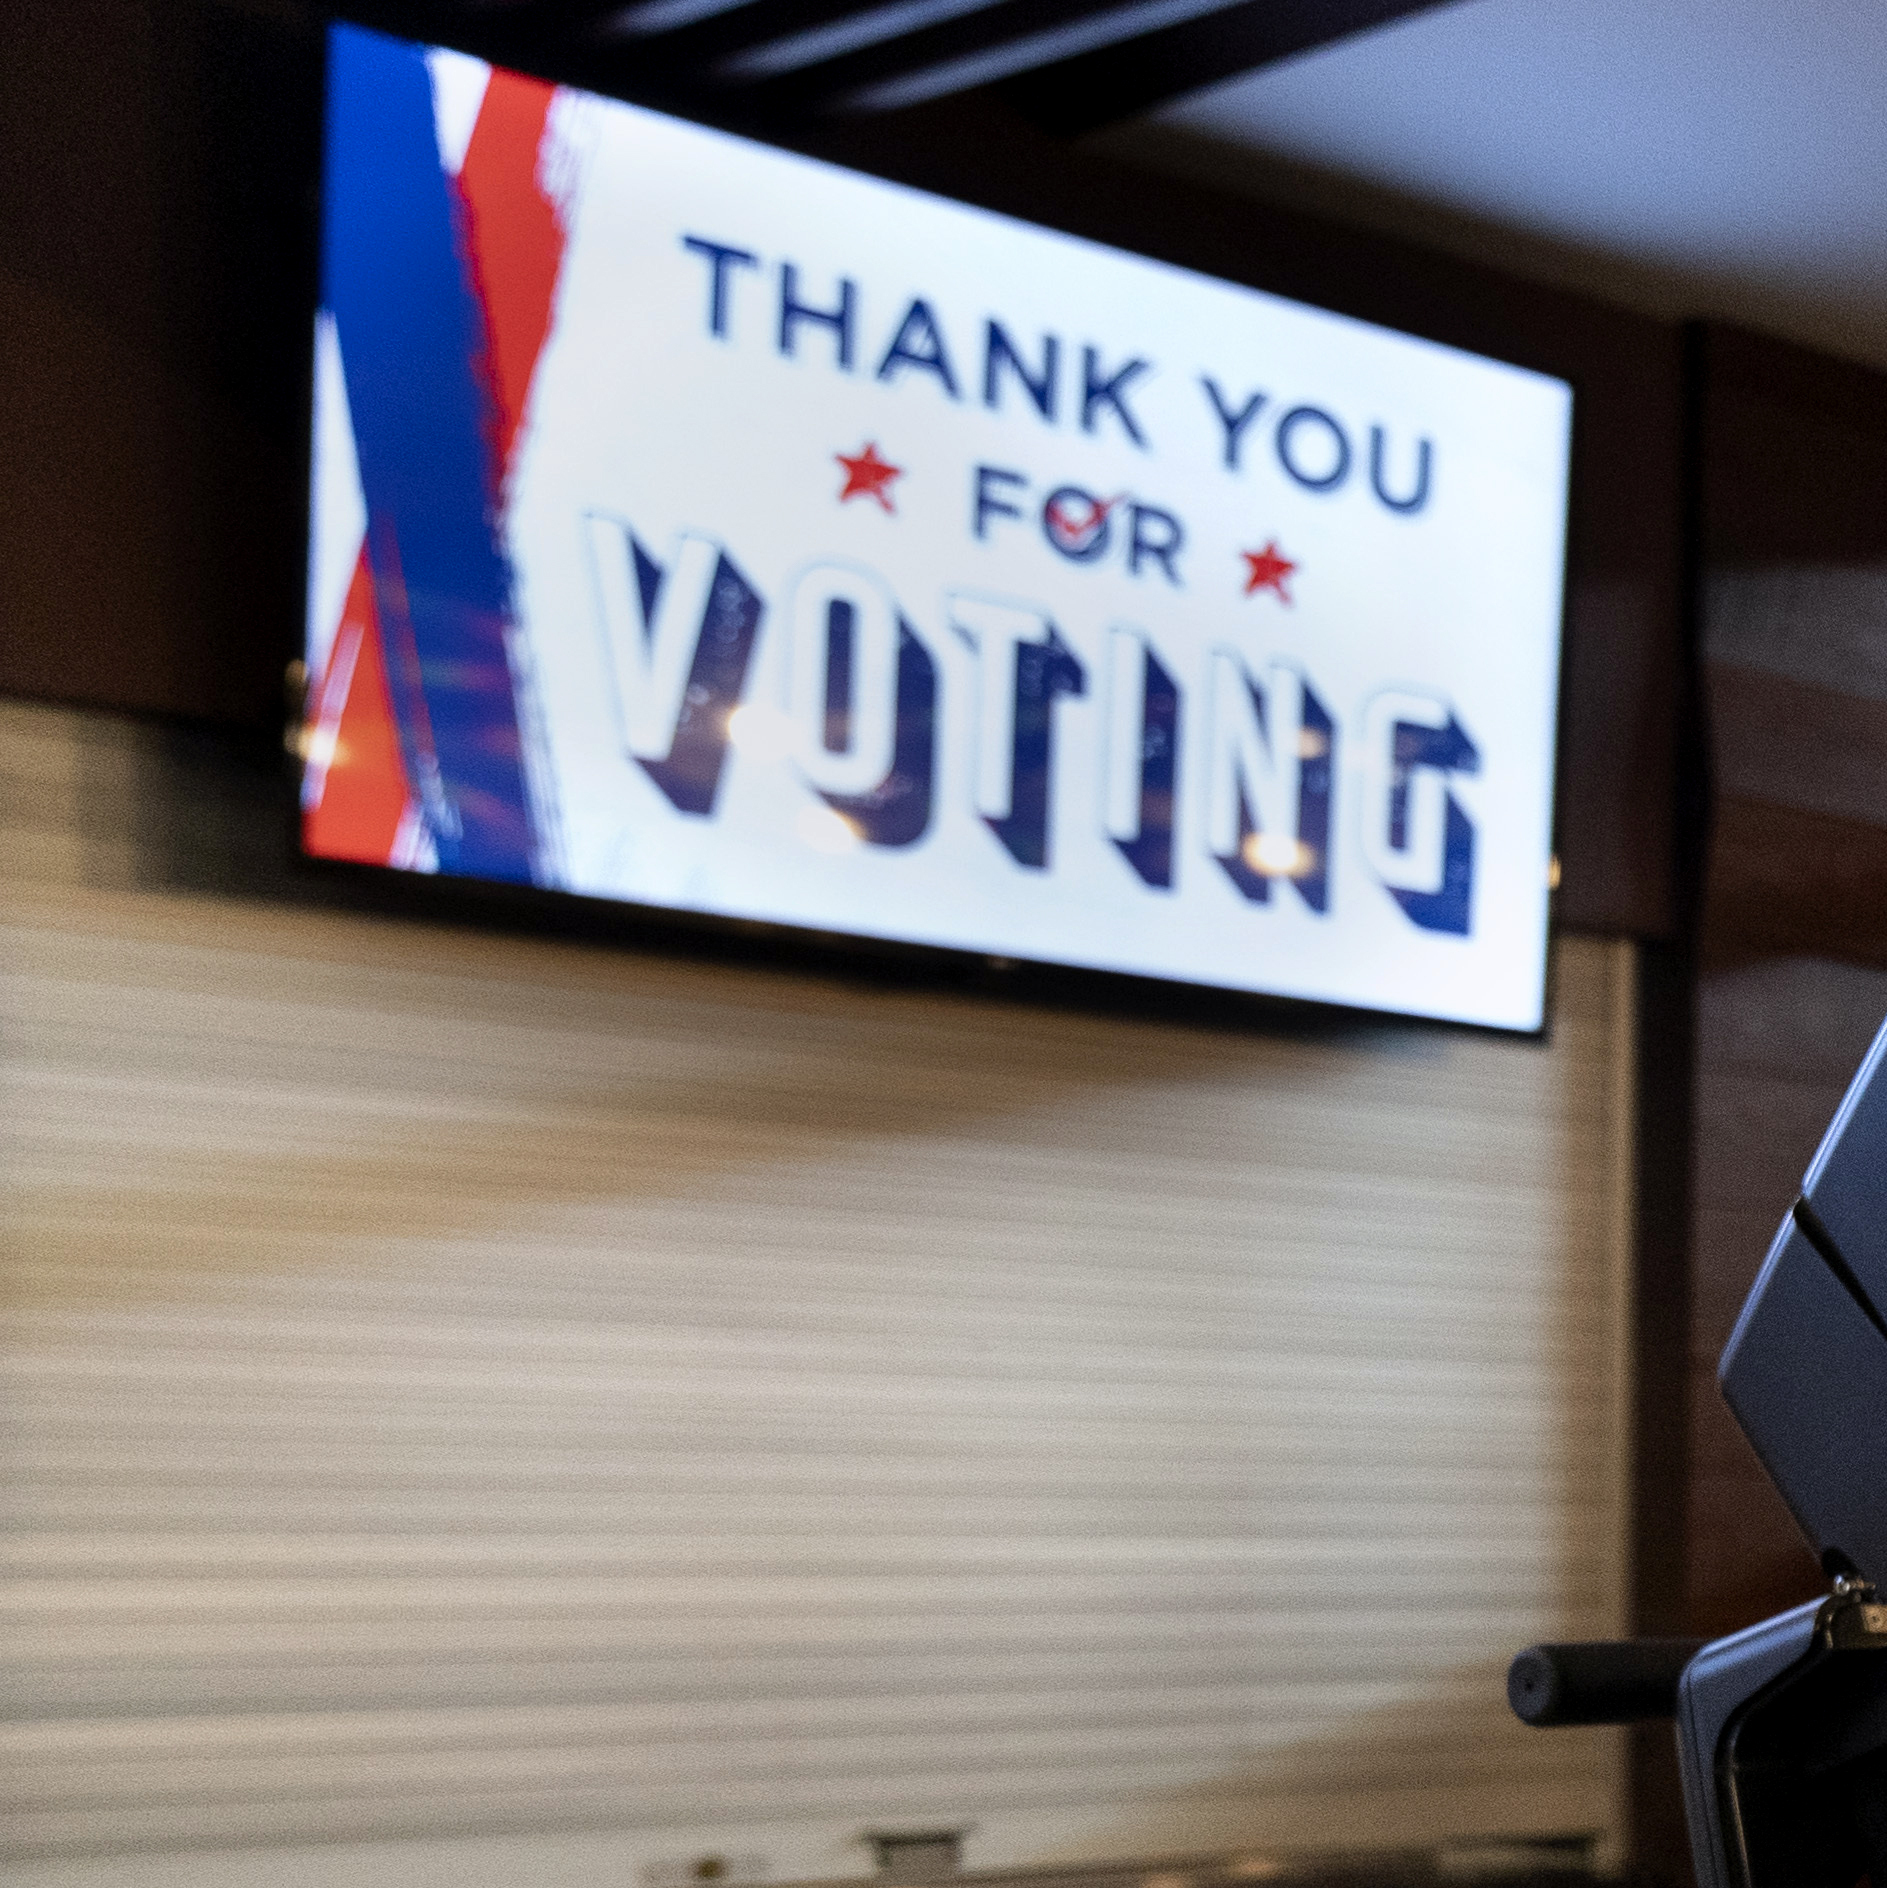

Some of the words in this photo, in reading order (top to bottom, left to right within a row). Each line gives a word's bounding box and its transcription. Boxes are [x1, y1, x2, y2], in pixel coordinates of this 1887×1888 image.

[682, 233, 1156, 449] THANK
[1199, 374, 1435, 516] YOU
[971, 461, 1187, 588] FOR
[583, 508, 1482, 940] VOTING
